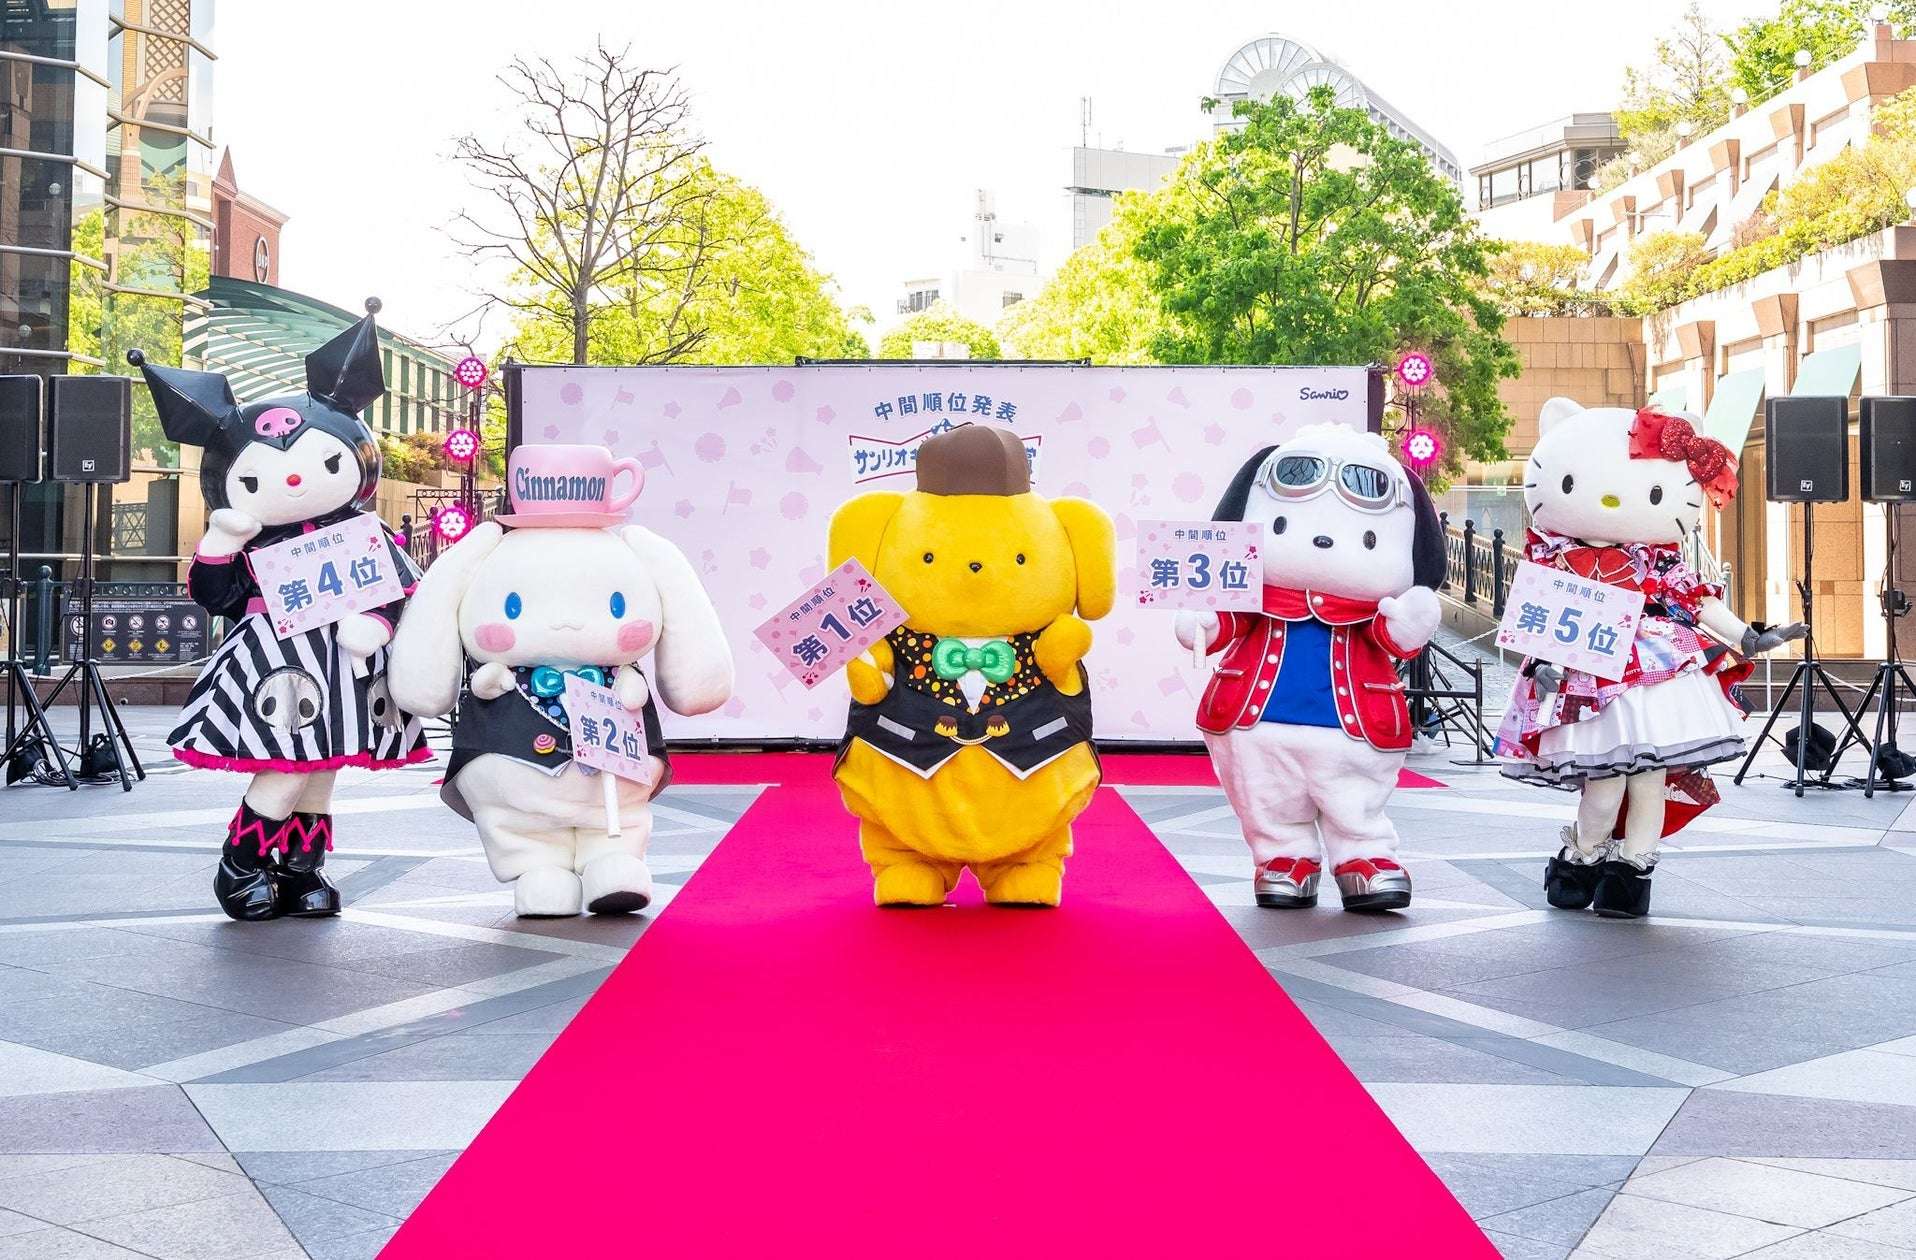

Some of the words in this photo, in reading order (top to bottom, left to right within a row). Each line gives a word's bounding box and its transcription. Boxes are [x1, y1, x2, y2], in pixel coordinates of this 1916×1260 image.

[874, 392, 1018, 424] 中間順位発表
[1299, 386, 1349, 401] Sanrio
[515, 466, 606, 502] Cinnamon
[290, 532, 345, 558] 中間順位
[1174, 529, 1227, 541] 中間順位
[277, 556, 384, 614] 第4位
[1150, 553, 1249, 590] 第3位
[789, 586, 836, 622] 中間順位
[1552, 579, 1606, 603] 中間順位
[792, 597, 883, 667] 第1位
[1516, 601, 1619, 656] 第5位
[590, 690, 623, 711] 中間順位
[580, 714, 641, 761] 第2位
